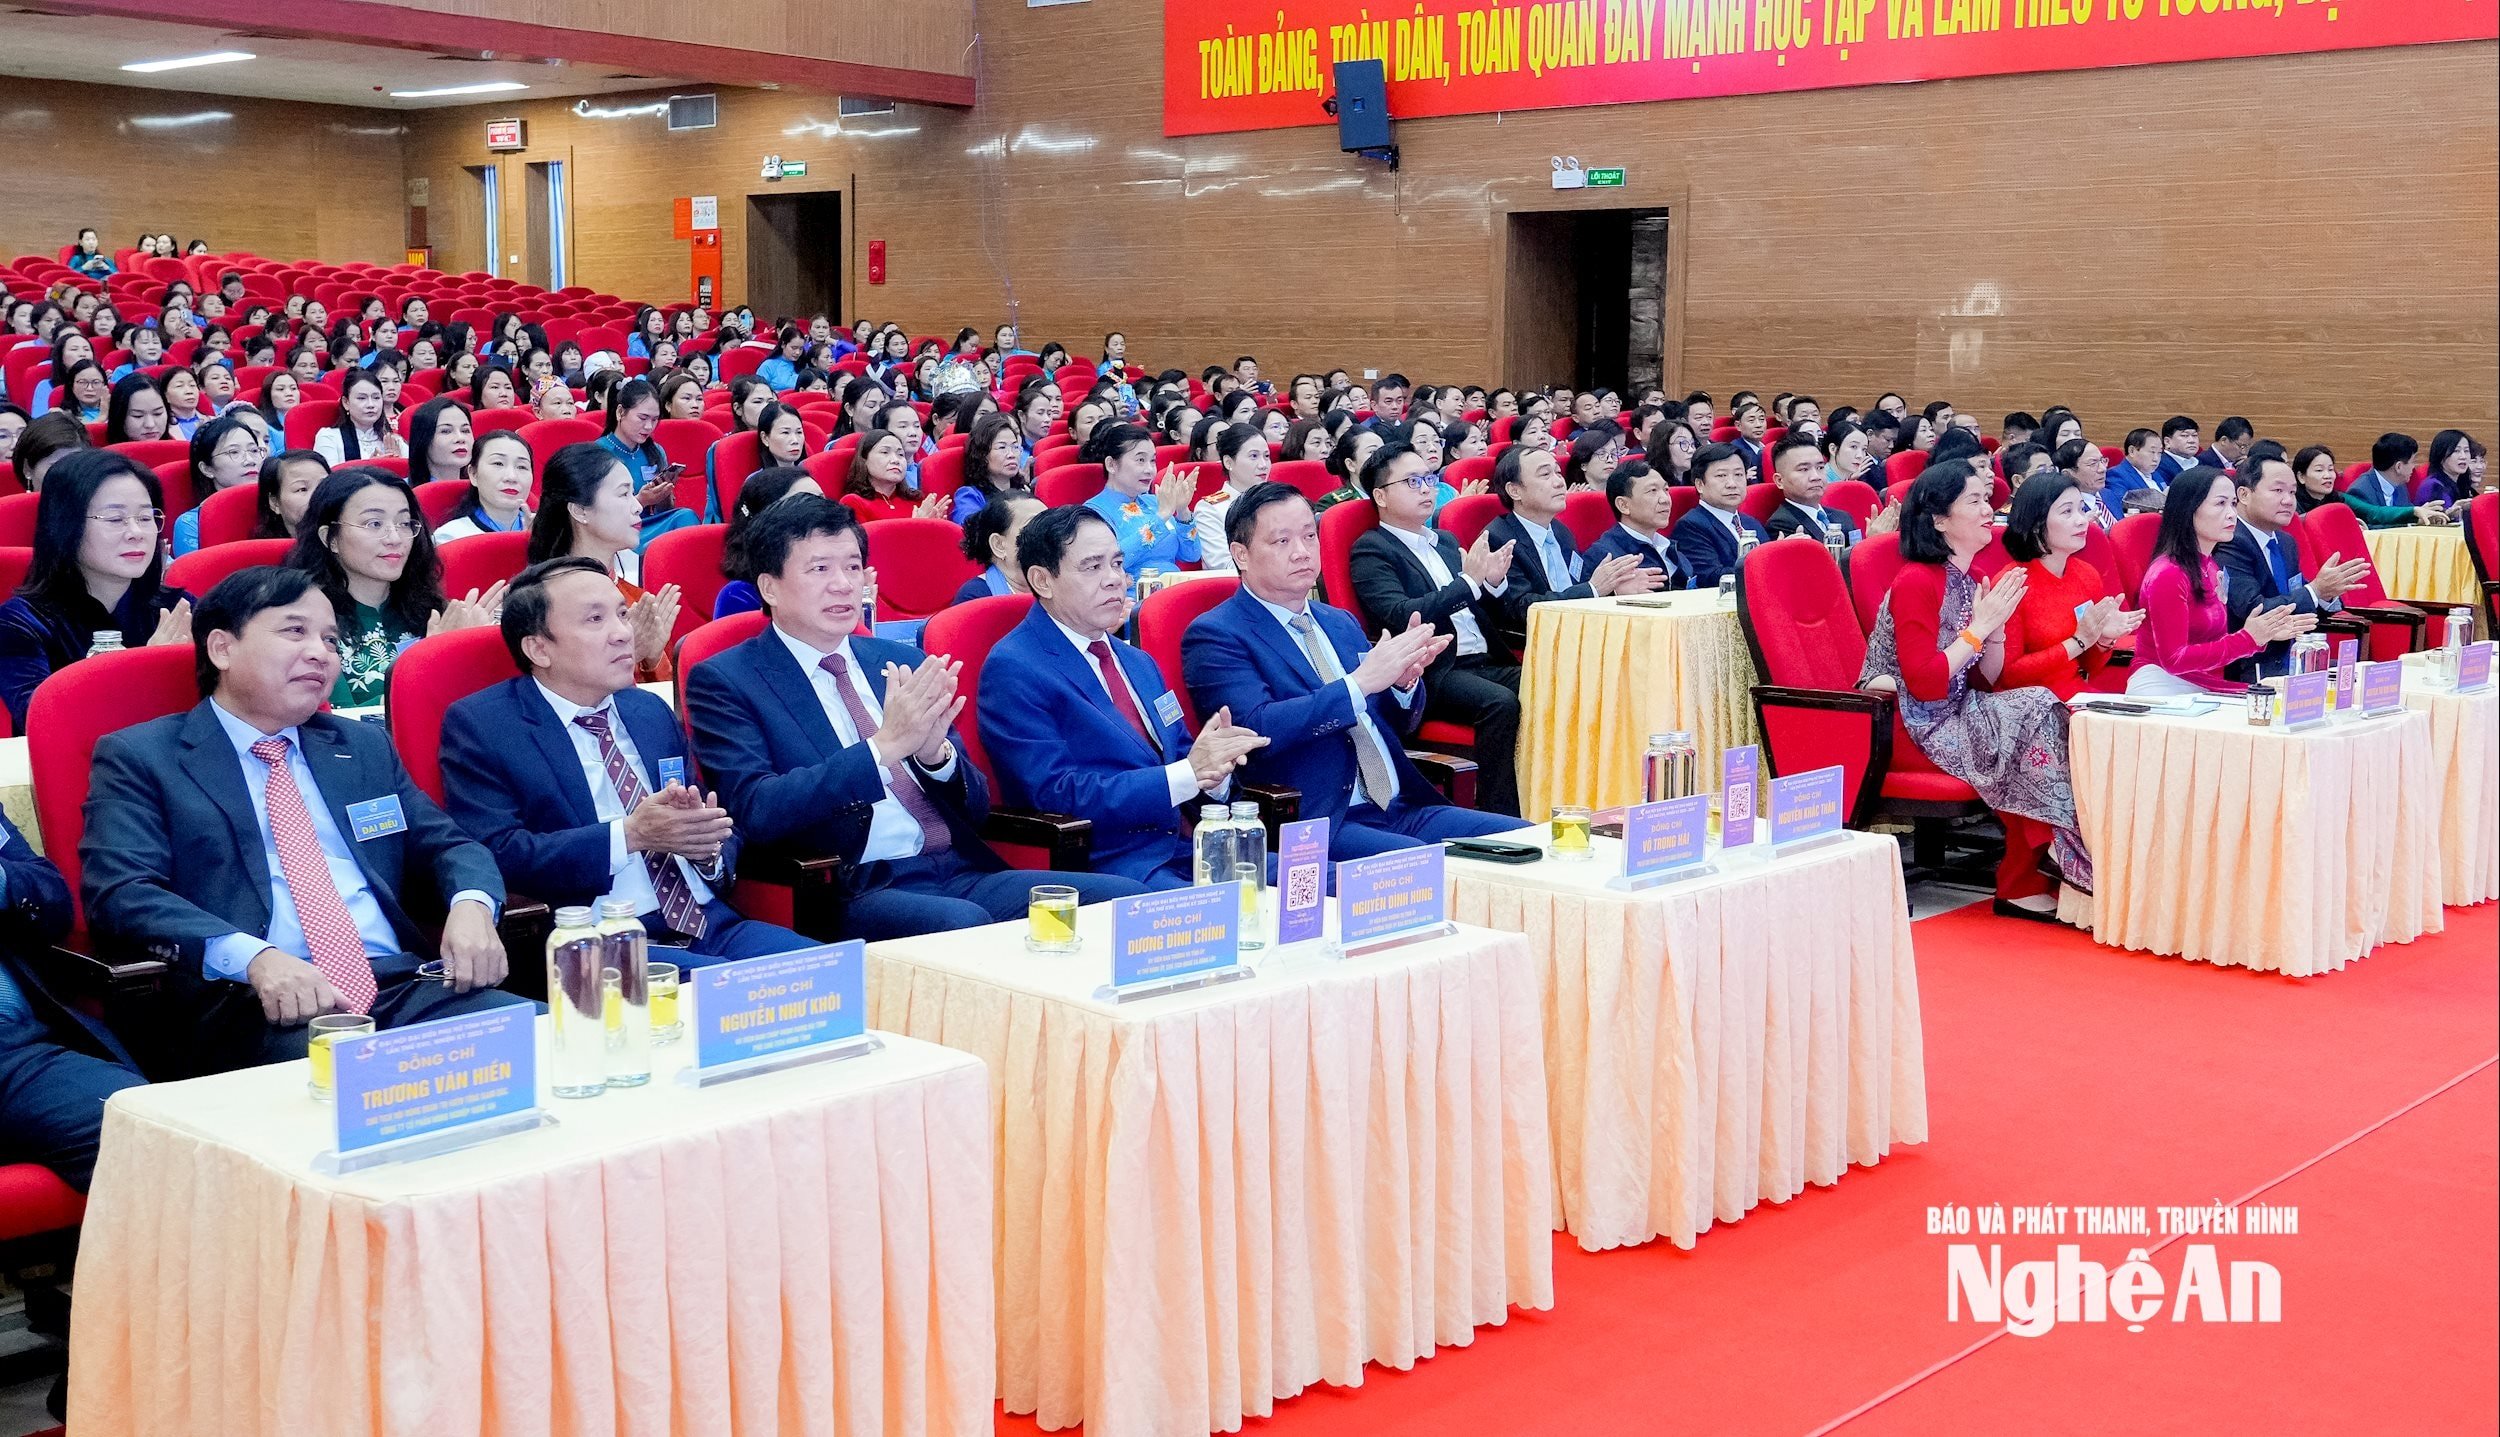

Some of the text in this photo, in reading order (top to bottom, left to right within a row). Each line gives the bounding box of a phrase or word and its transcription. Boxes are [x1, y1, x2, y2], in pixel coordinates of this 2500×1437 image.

[1199, 24, 1252, 99] TOÀN
[1258, 10, 1323, 97] ĐẢNG,
[1395, 2, 1450, 86] DÂN,
[1458, 0, 1520, 76] TOÀN
[1663, 0, 1745, 73] MẠNH
[1373, 873, 1413, 890] ĐỒNG CHÍ
[1153, 910, 1202, 929] ĐỒNG CHÍ
[749, 976, 813, 1001] ĐỒNG CHÍ
[721, 991, 841, 1032] NGUYỄN NHƯ KHÔI
[398, 1043, 475, 1072] ĐỒNG CHÍ
[362, 1080, 429, 1108] TRƯƠNG
[435, 1070, 468, 1093] VĂN
